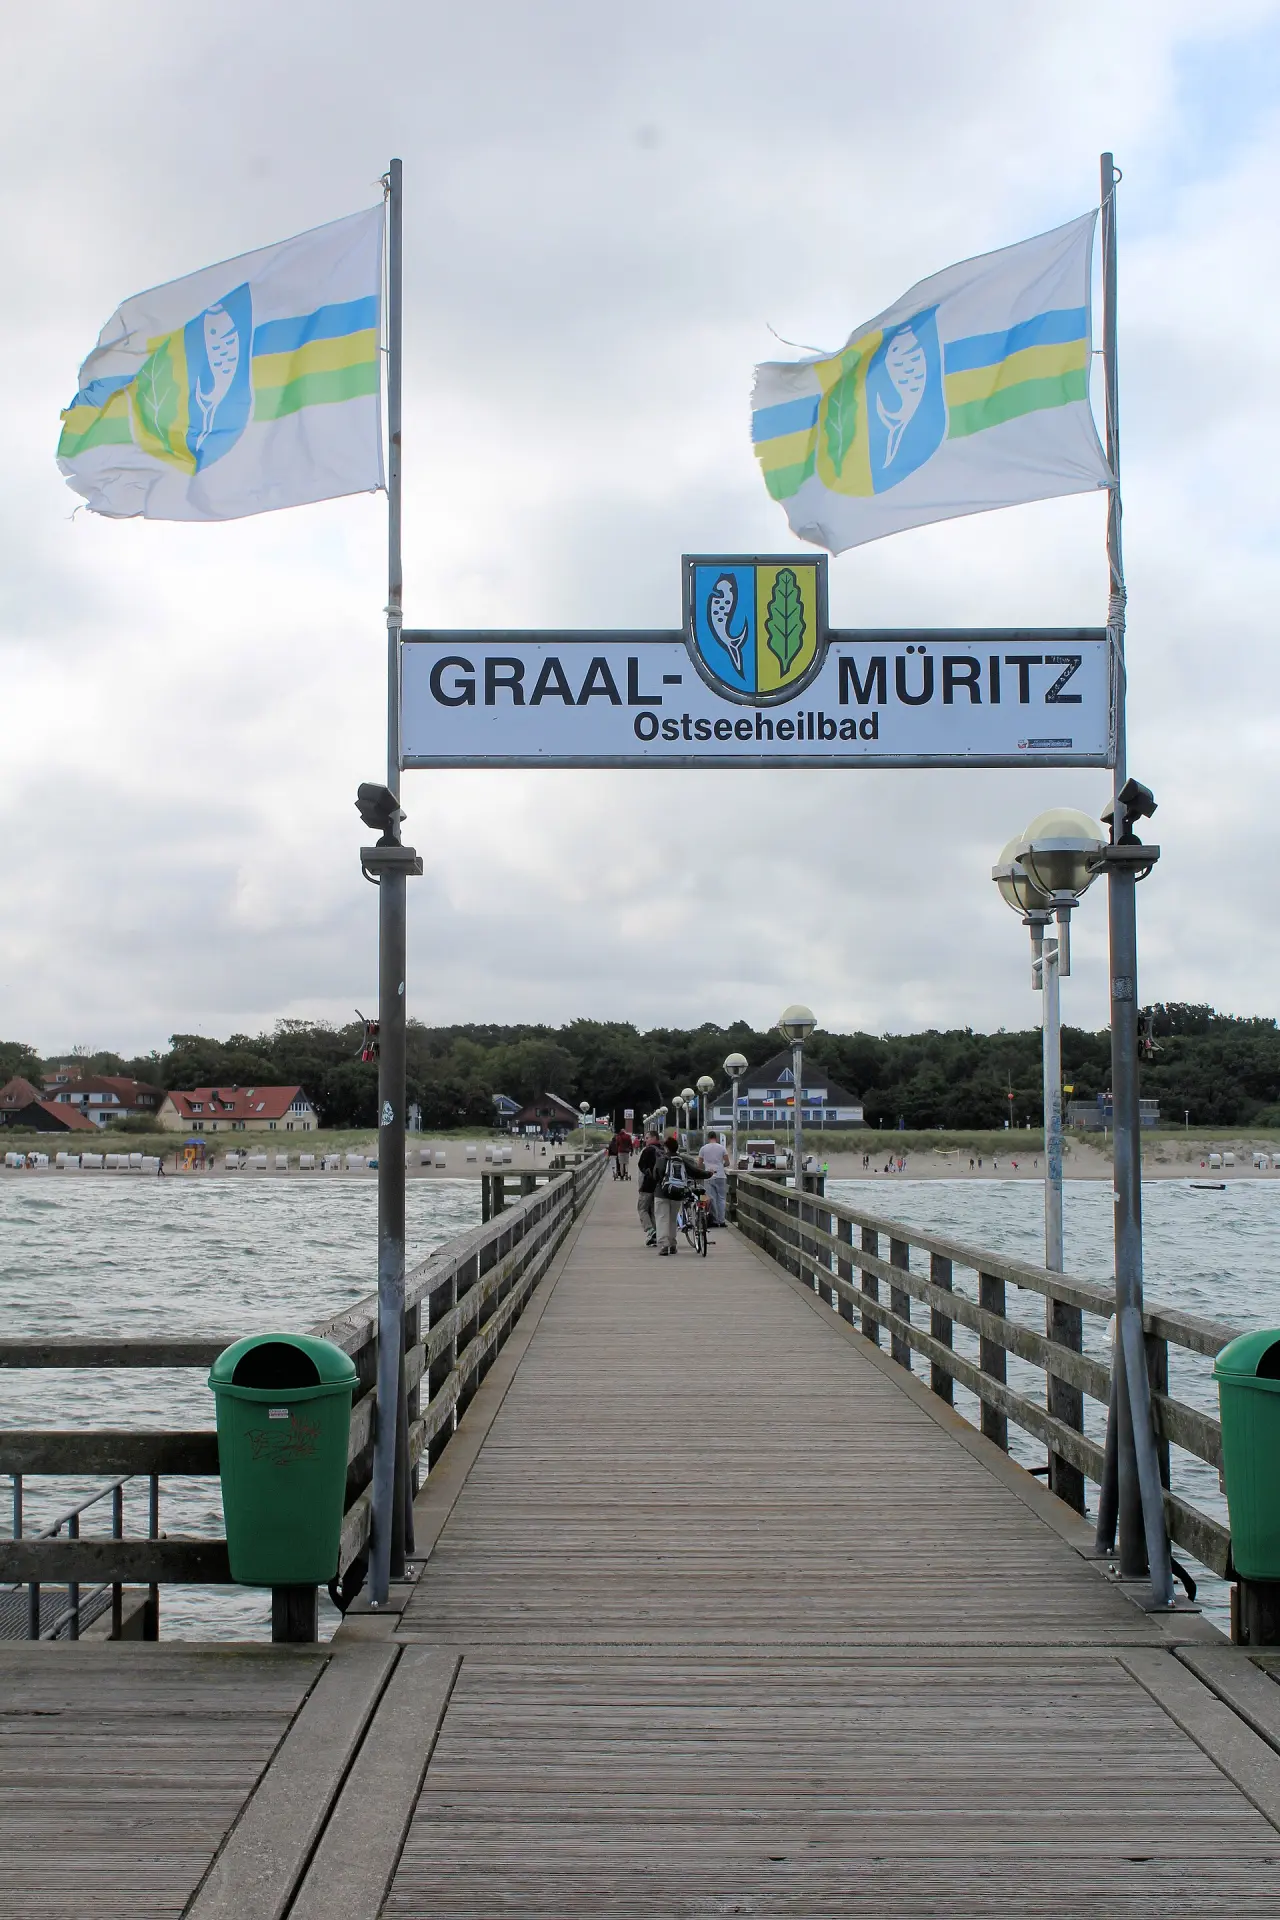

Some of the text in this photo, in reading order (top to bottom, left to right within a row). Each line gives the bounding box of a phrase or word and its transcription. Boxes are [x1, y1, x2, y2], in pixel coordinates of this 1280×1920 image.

[429, 655, 682, 707] GRAAL-
[838, 645, 1083, 706] MÜRITZ
[633, 711, 879, 742] Ostseeheilbad
